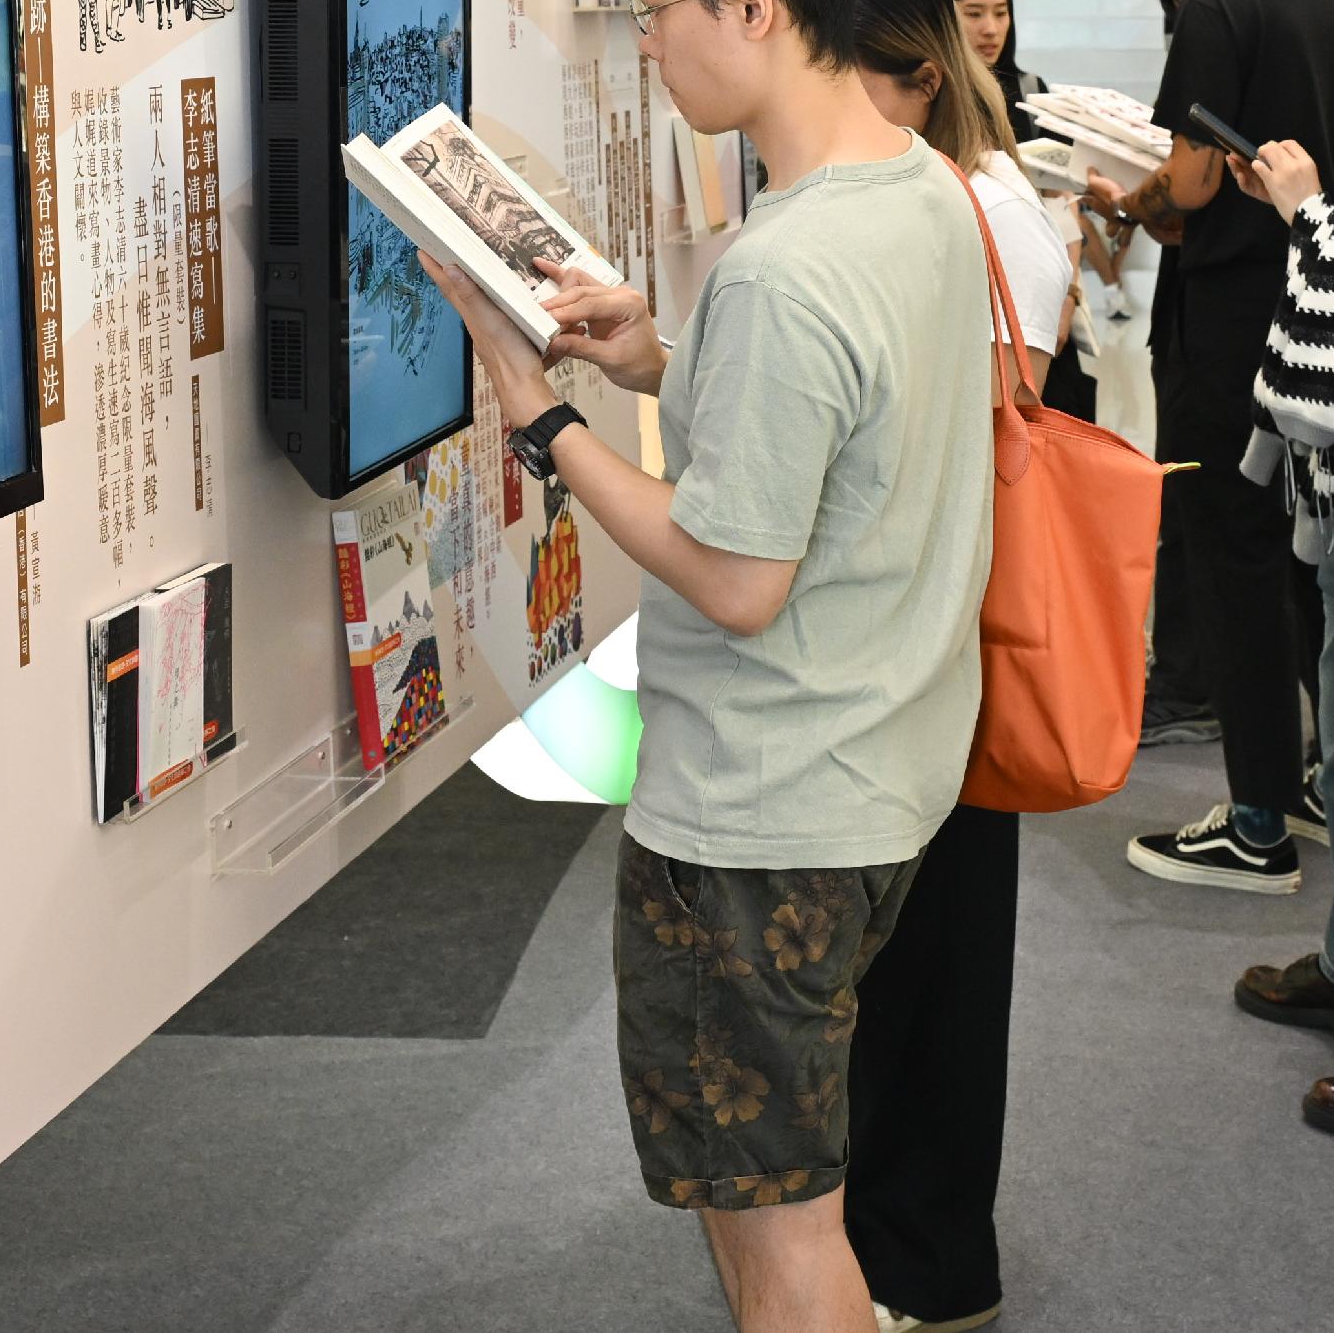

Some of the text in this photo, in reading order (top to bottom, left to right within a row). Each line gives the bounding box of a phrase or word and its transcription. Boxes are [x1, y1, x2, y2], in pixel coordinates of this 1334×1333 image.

[70, 89, 88, 263] 與人文關懷。
[183, 87, 206, 346] 李志清速寫集
